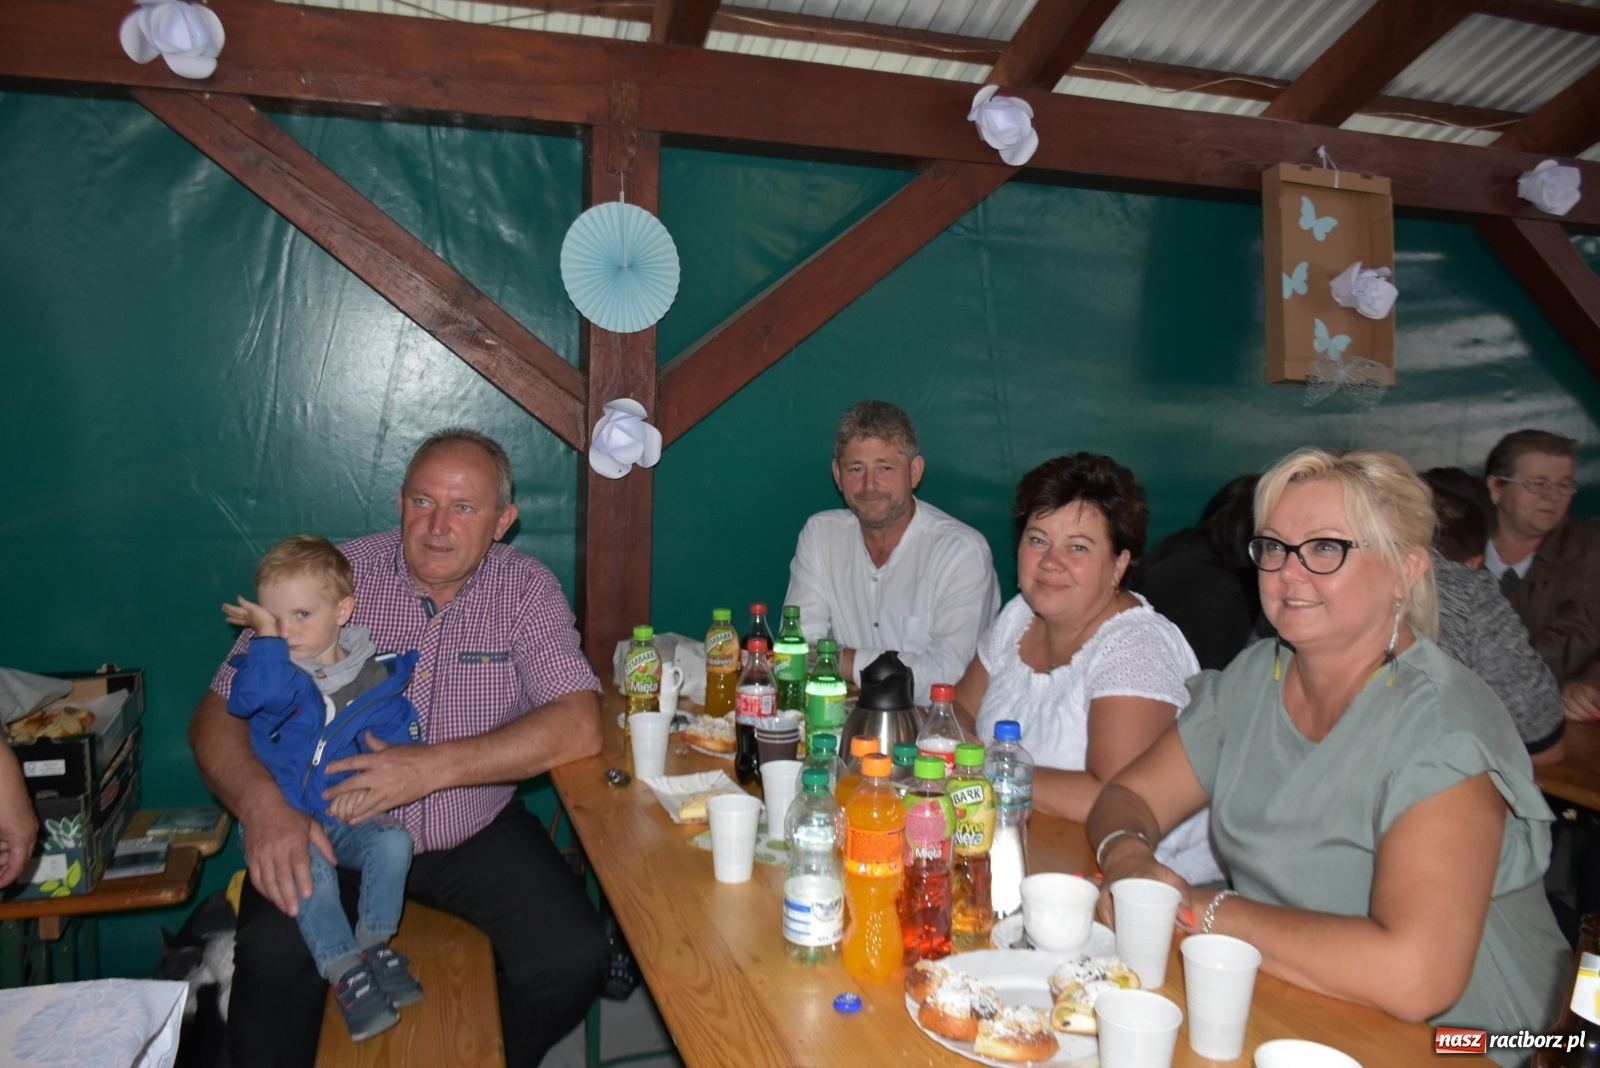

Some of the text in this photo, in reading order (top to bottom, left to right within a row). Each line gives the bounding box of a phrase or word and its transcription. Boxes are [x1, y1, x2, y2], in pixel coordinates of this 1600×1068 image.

[625, 651, 656, 674] TYMBARK
[630, 681, 658, 694] Mięta
[953, 787, 981, 805] BARK
[915, 847, 942, 861] Mięta
